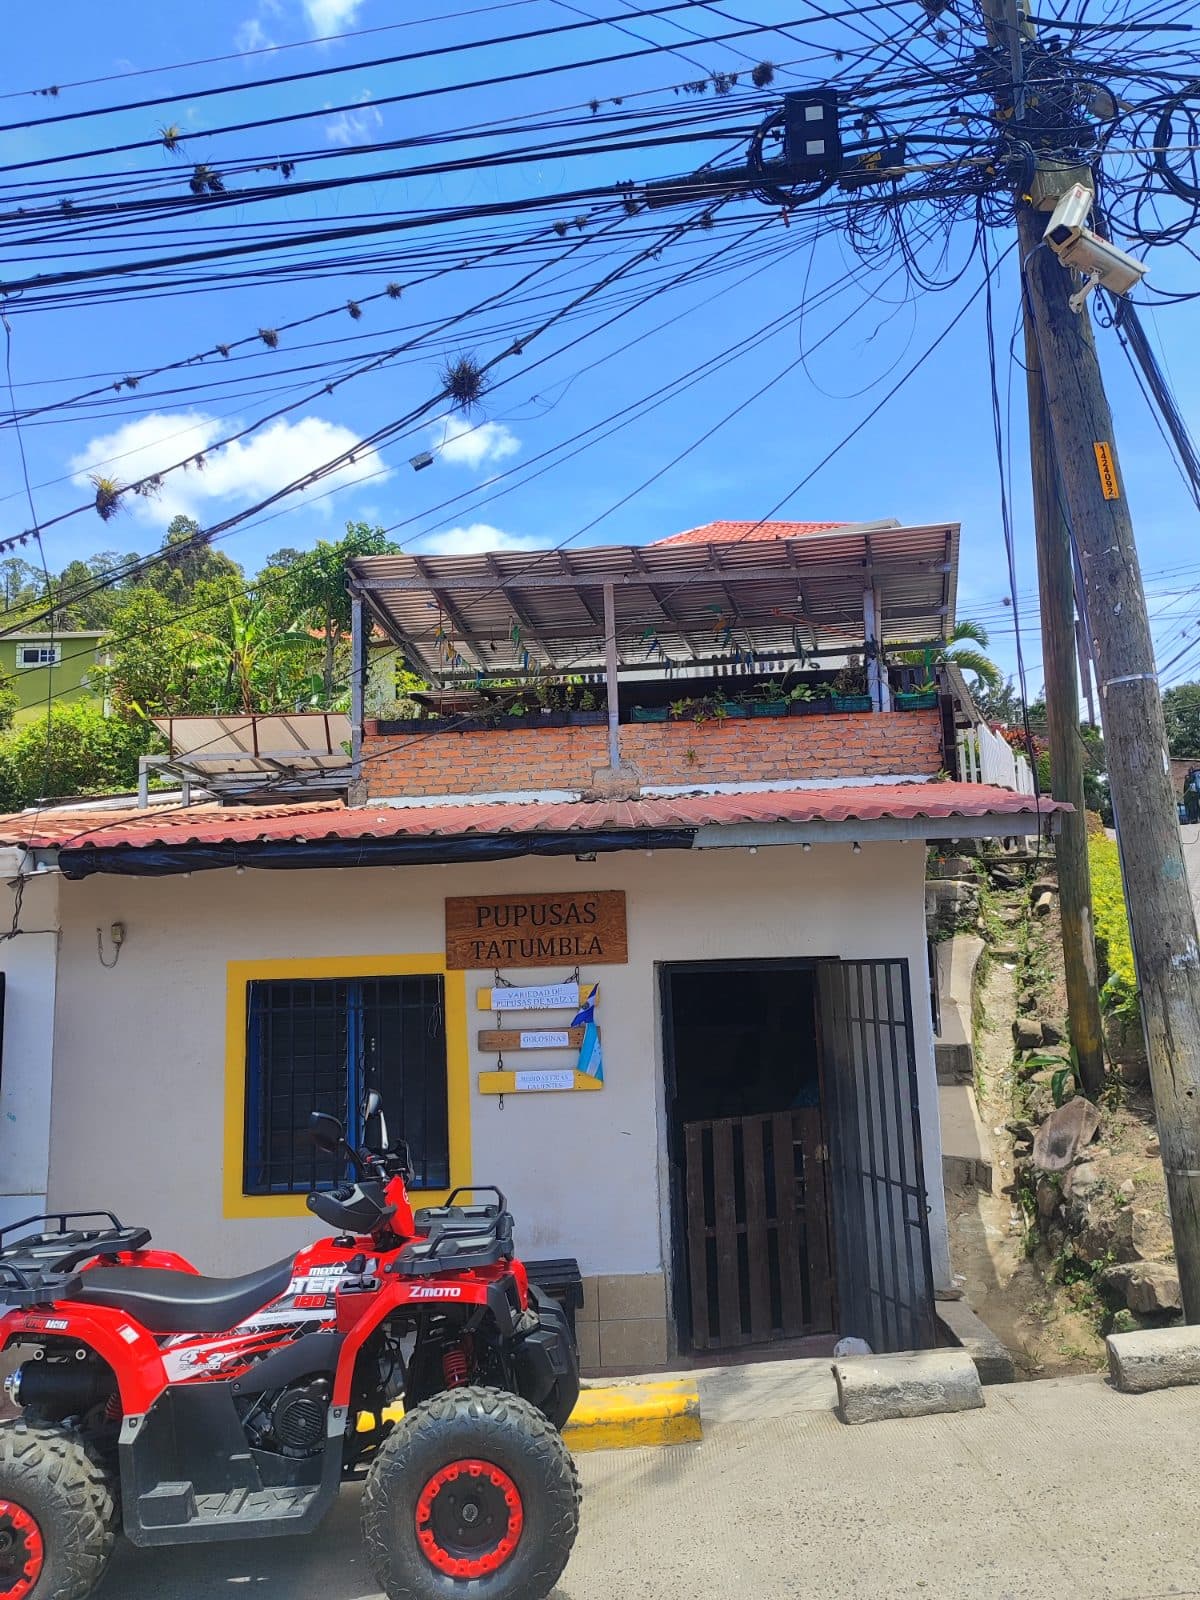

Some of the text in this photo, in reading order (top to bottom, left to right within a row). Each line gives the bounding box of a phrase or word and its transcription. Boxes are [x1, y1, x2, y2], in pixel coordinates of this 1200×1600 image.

[476, 902, 597, 928] PUPUSAS
[470, 936, 604, 960] TATUMBLA
[507, 987, 563, 999] VARIEDAD DE
[496, 999, 532, 1008] PUPUSAS
[533, 998, 545, 1006] DE
[523, 1035, 566, 1043] GOLOSINAS
[294, 1295, 328, 1309] 180
